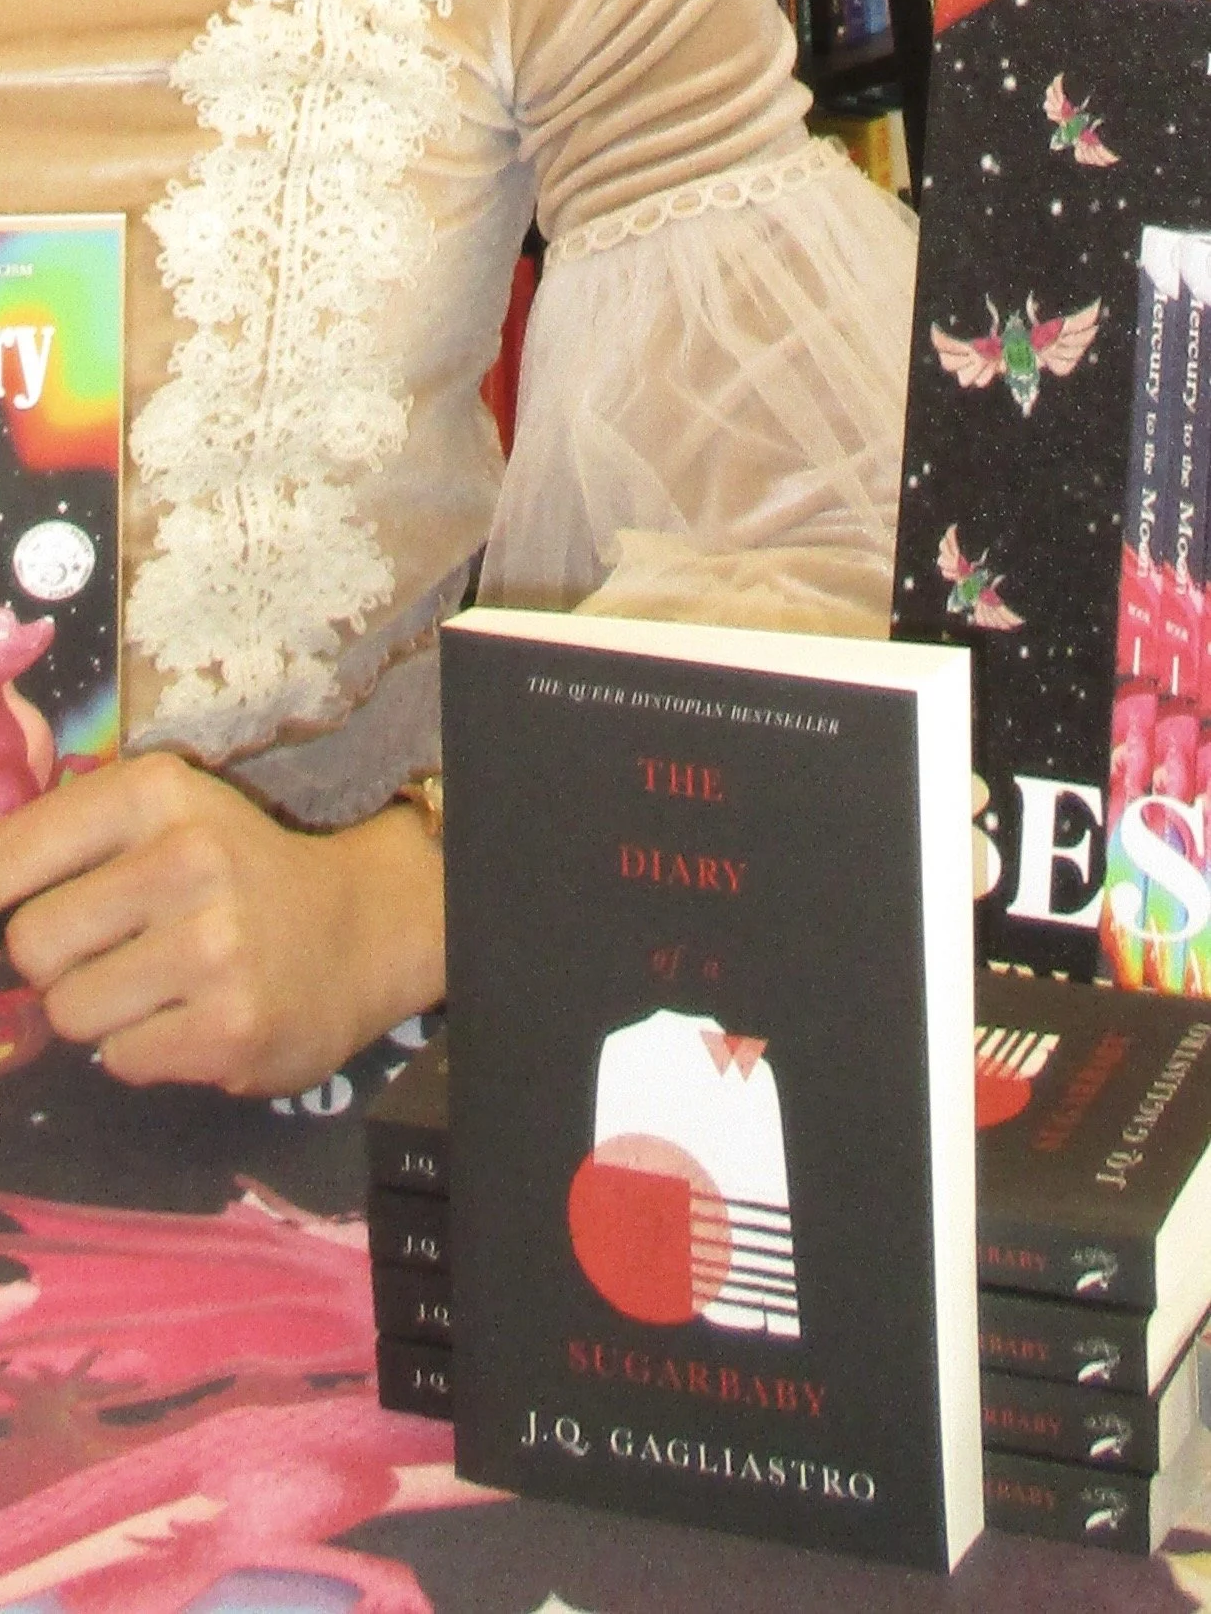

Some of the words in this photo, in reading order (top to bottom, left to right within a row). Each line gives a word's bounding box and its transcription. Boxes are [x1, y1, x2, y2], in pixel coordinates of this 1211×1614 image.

[1144, 292, 1167, 403] ercury
[1181, 300, 1204, 415] ercury
[1137, 487, 1158, 579] Moon
[1175, 501, 1195, 595] Moon
[528, 675, 562, 695] THE
[568, 683, 624, 705] QUEER
[631, 691, 724, 718] DYSTOPIAN
[730, 703, 840, 735] BESTSELLER
[637, 757, 726, 802] THE
[619, 843, 748, 894] DIARY
[567, 1339, 827, 1421] SUGARBABY
[611, 1429, 876, 1504] GAGLIASTRO
